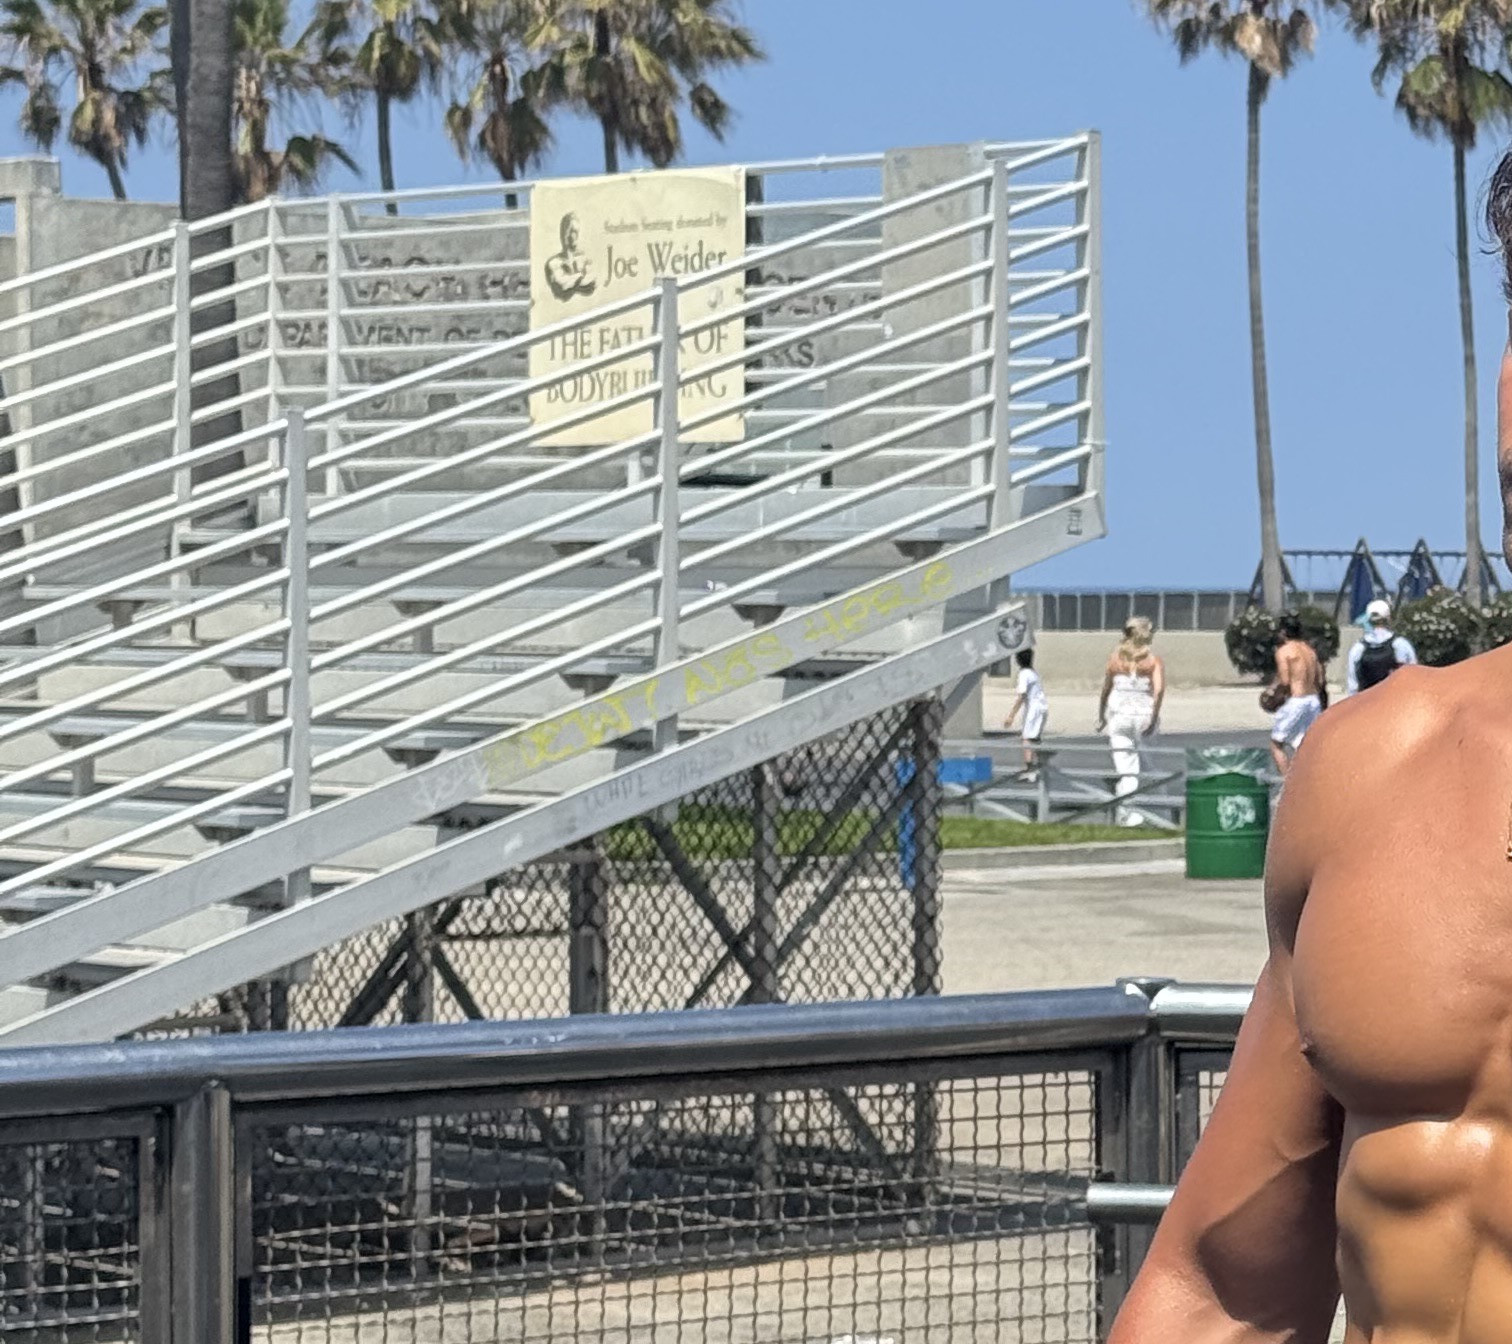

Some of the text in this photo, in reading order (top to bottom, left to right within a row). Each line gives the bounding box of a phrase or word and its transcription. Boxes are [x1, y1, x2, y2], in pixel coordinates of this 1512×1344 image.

[603, 239, 728, 288] Joe Weider
[549, 327, 592, 362] THE
[693, 323, 728, 355] OF
